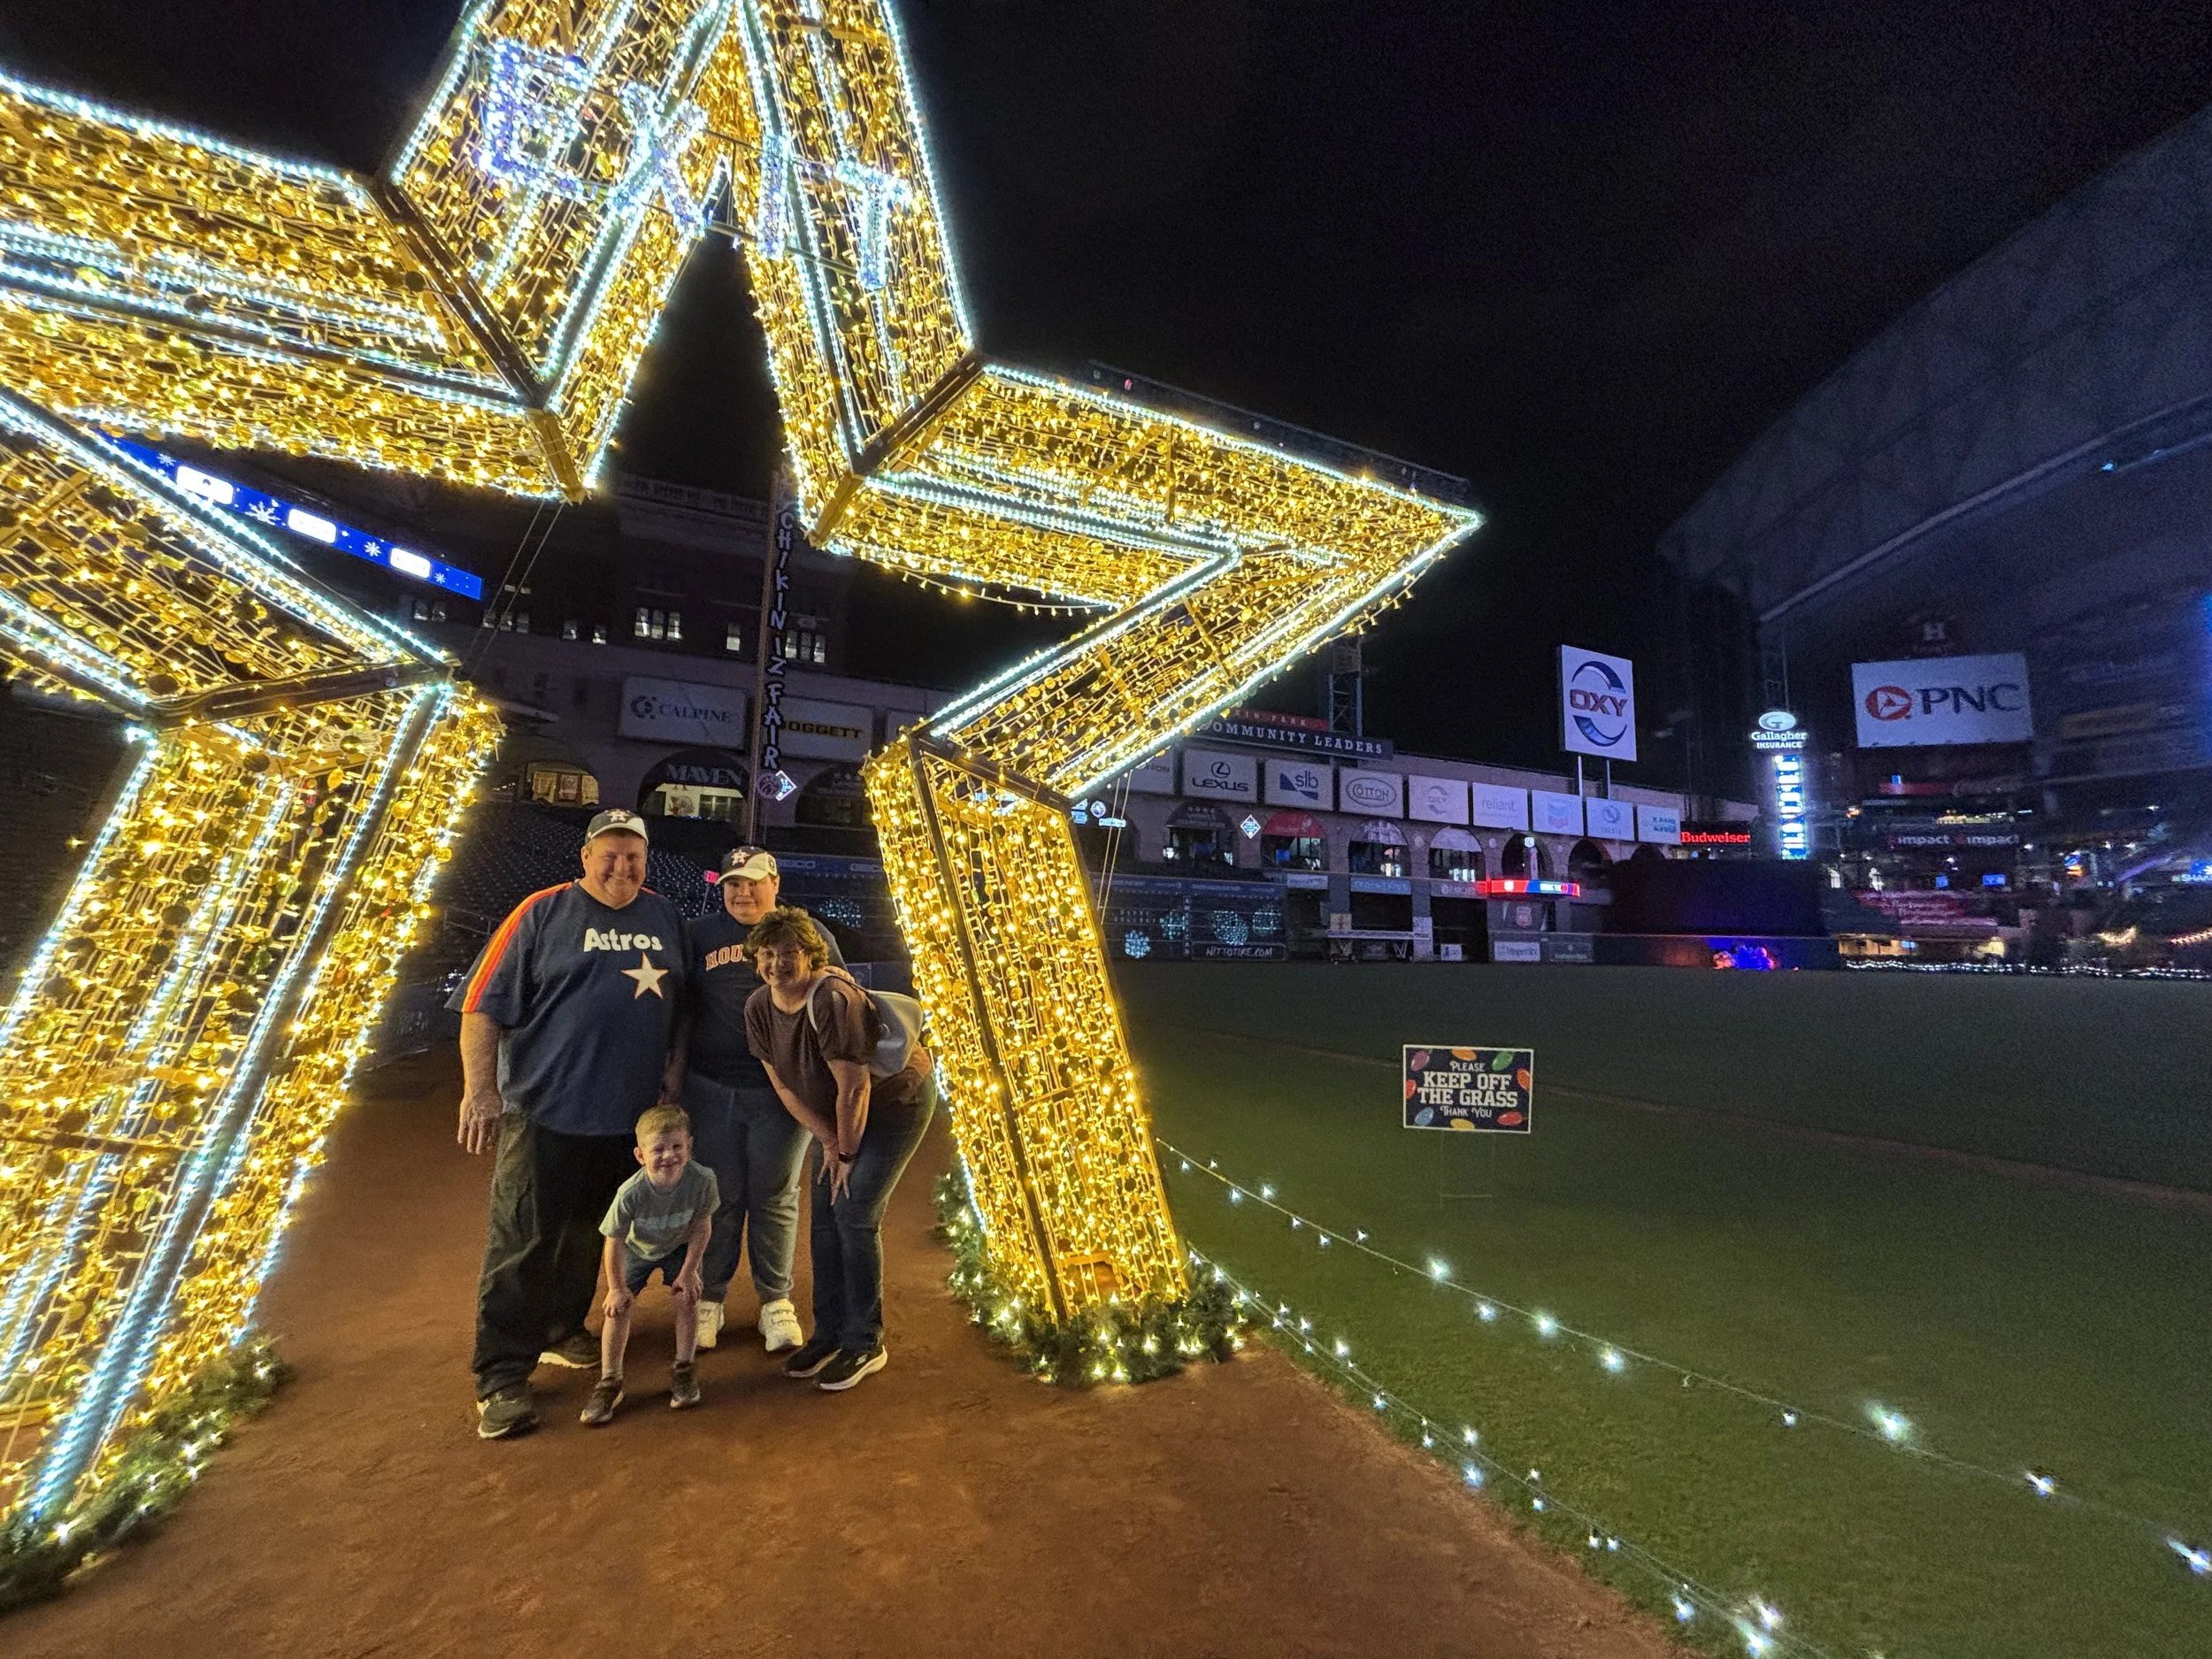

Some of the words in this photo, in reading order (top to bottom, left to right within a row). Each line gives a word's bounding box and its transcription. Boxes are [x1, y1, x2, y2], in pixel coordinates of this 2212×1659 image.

[1570, 688, 1629, 717] OXY
[1916, 683, 2021, 715] PNC
[658, 705, 734, 724] CALPINE
[1271, 715, 1307, 726] PARK
[1751, 732, 1808, 741] Gallagher
[1314, 735, 1383, 755] LEADERS
[668, 764, 742, 787] MAVEN
[1294, 770, 1318, 787] slb
[1192, 777, 1249, 792] LEXUS
[1352, 785, 1389, 801] COTTON
[1481, 797, 1517, 812] reliant
[1681, 832, 1750, 843] Budweiser
[1898, 834, 1950, 846] impact
[1967, 834, 2019, 846] impact
[778, 859, 816, 869] EICO
[850, 863, 883, 872] GEIC
[583, 927, 663, 953] Astros
[705, 943, 749, 971] HOU
[1205, 946, 1272, 957] NITTOTIRE.COM
[1450, 1061, 1486, 1072] PLEASE
[1423, 1071, 1471, 1089] KEEP
[1477, 1073, 1513, 1091] OFF
[1417, 1087, 1454, 1105] THE
[1459, 1089, 1518, 1108] GRASS
[1440, 1106, 1469, 1118] THANK
[1471, 1107, 1493, 1118] YOU
